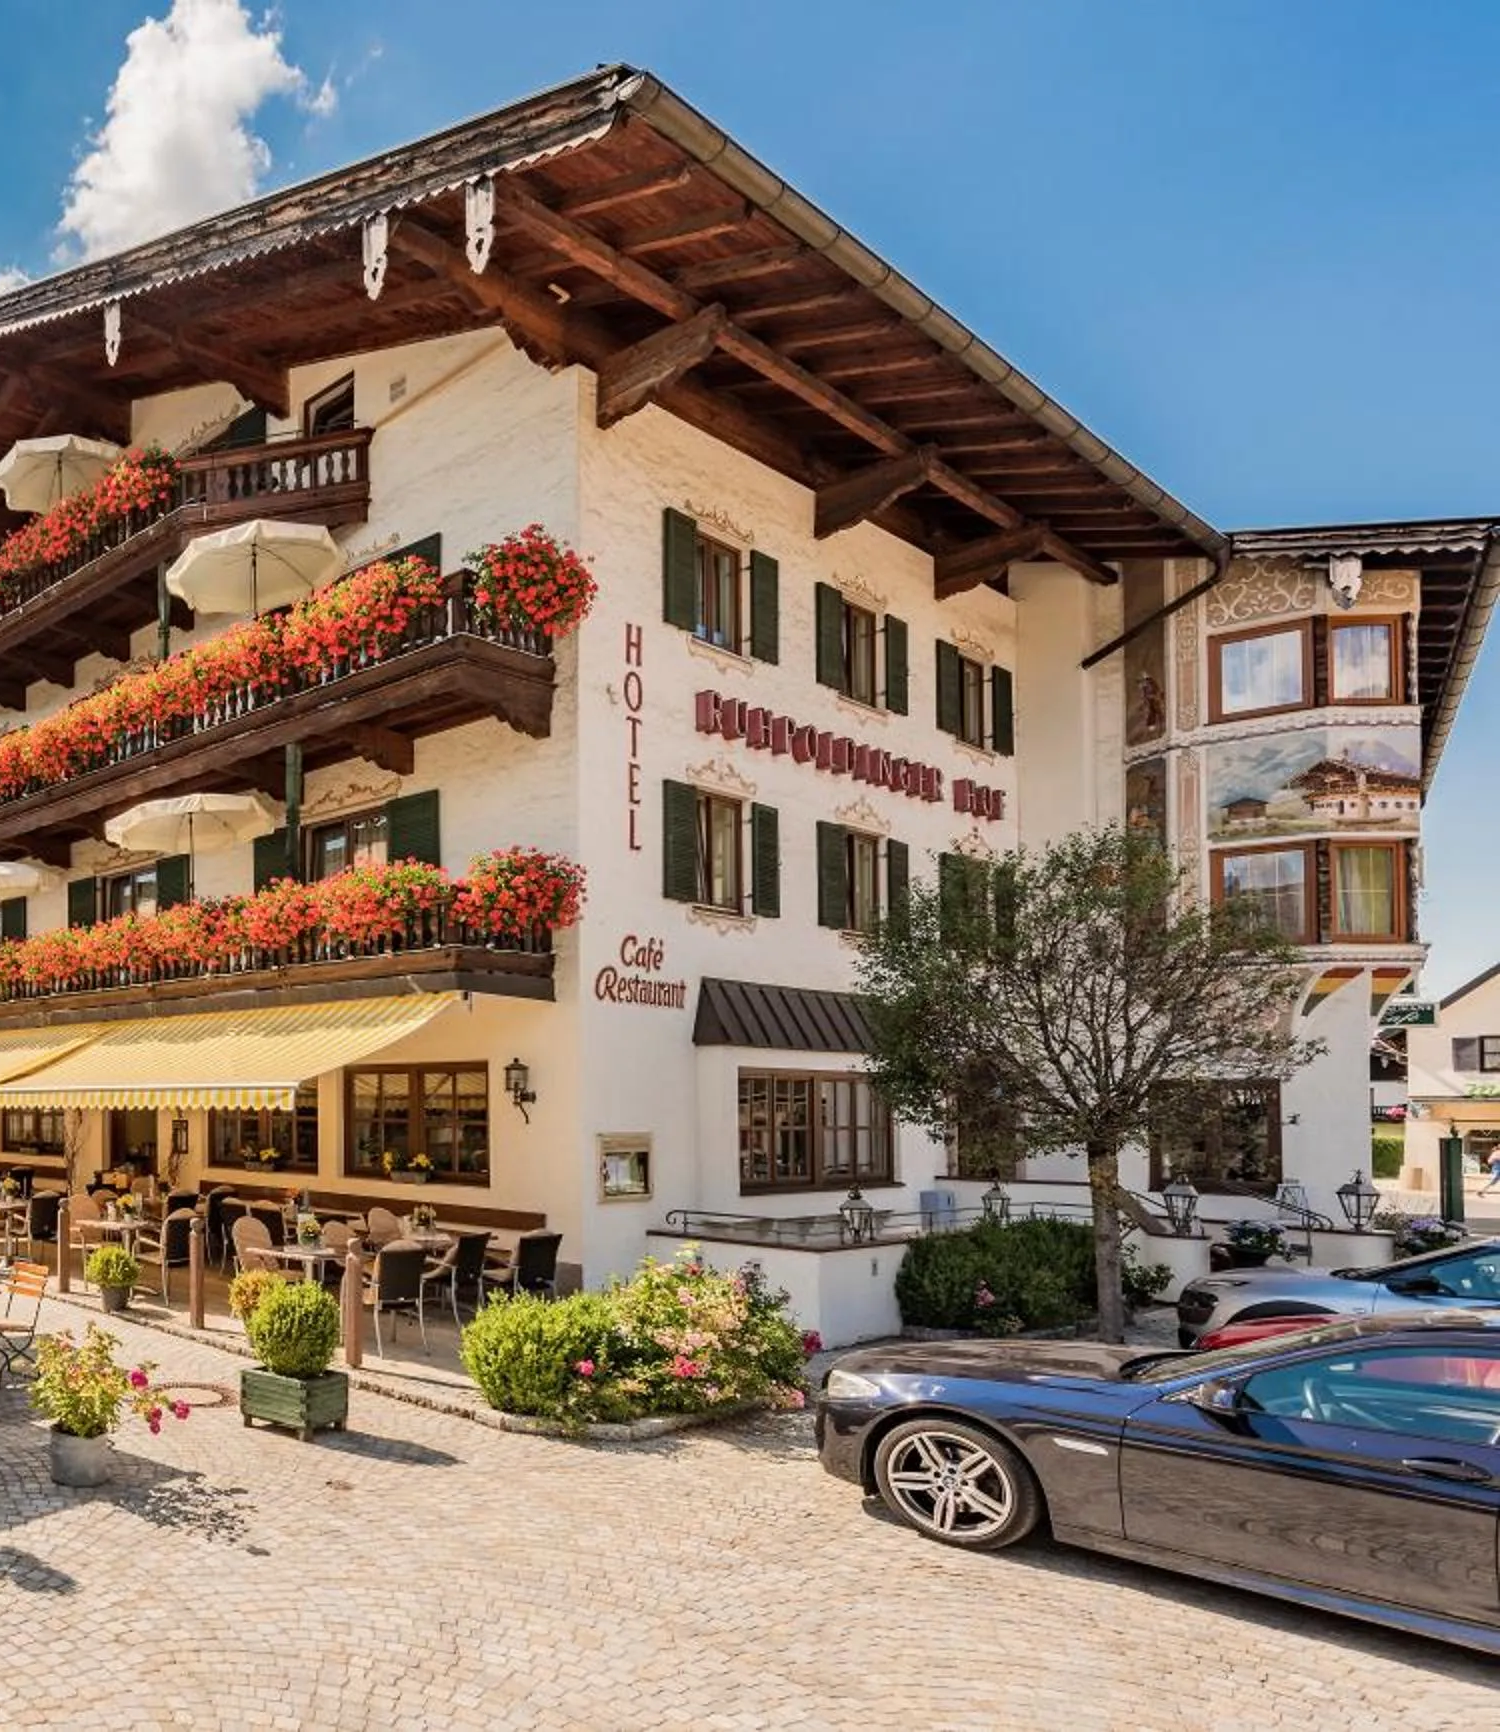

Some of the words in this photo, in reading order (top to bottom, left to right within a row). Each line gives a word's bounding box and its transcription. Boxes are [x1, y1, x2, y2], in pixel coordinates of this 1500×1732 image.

[624, 622, 643, 850] HOTEL
[952, 778, 1007, 822] HOF
[621, 935, 664, 973] Café
[595, 966, 687, 1009] Restaurant
